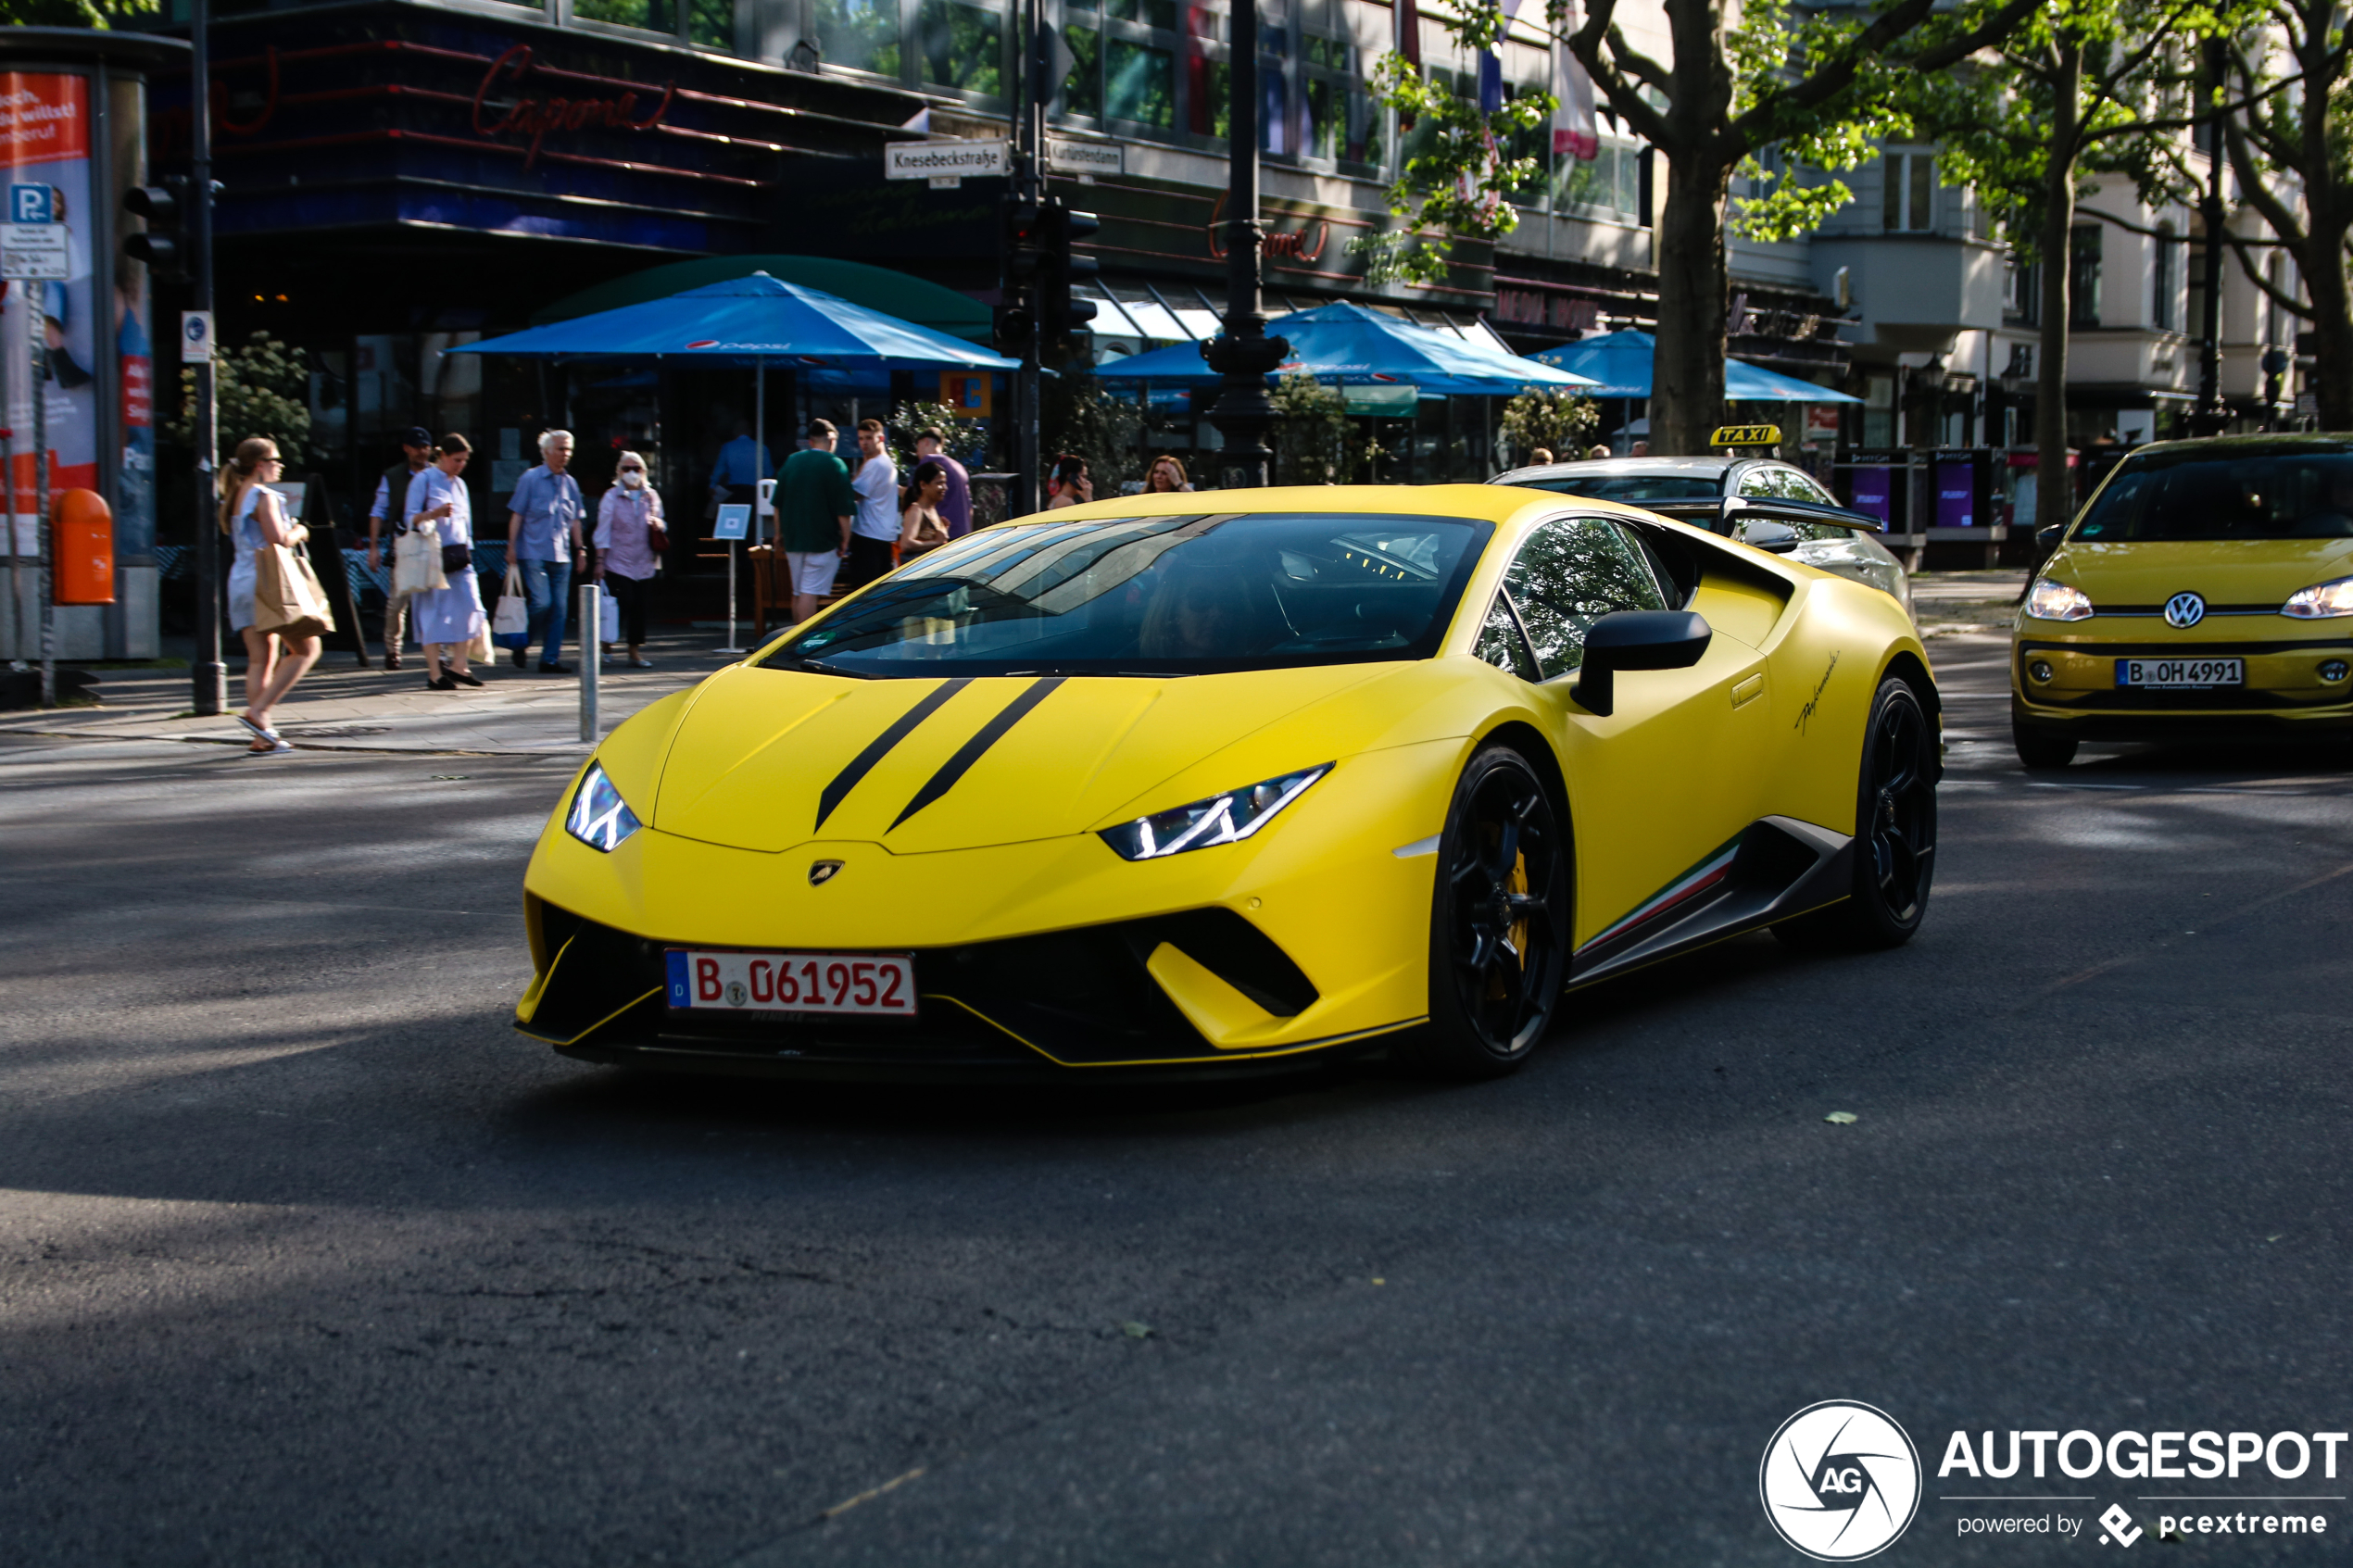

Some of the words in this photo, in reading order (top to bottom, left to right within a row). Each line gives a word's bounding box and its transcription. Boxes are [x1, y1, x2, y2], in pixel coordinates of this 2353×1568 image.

[472, 43, 677, 174] Capone
[894, 148, 998, 169] Knesebeckstraße
[19, 188, 43, 220] P
[718, 342, 792, 351] pepsi
[1722, 428, 1768, 442] TAXI
[2130, 662, 2144, 682] B
[2158, 662, 2184, 682] OH
[2188, 661, 2240, 682] 4991
[1793, 650, 1841, 737] Performante
[674, 984, 684, 997] D
[696, 958, 723, 1001] B
[749, 959, 905, 1008] 061952
